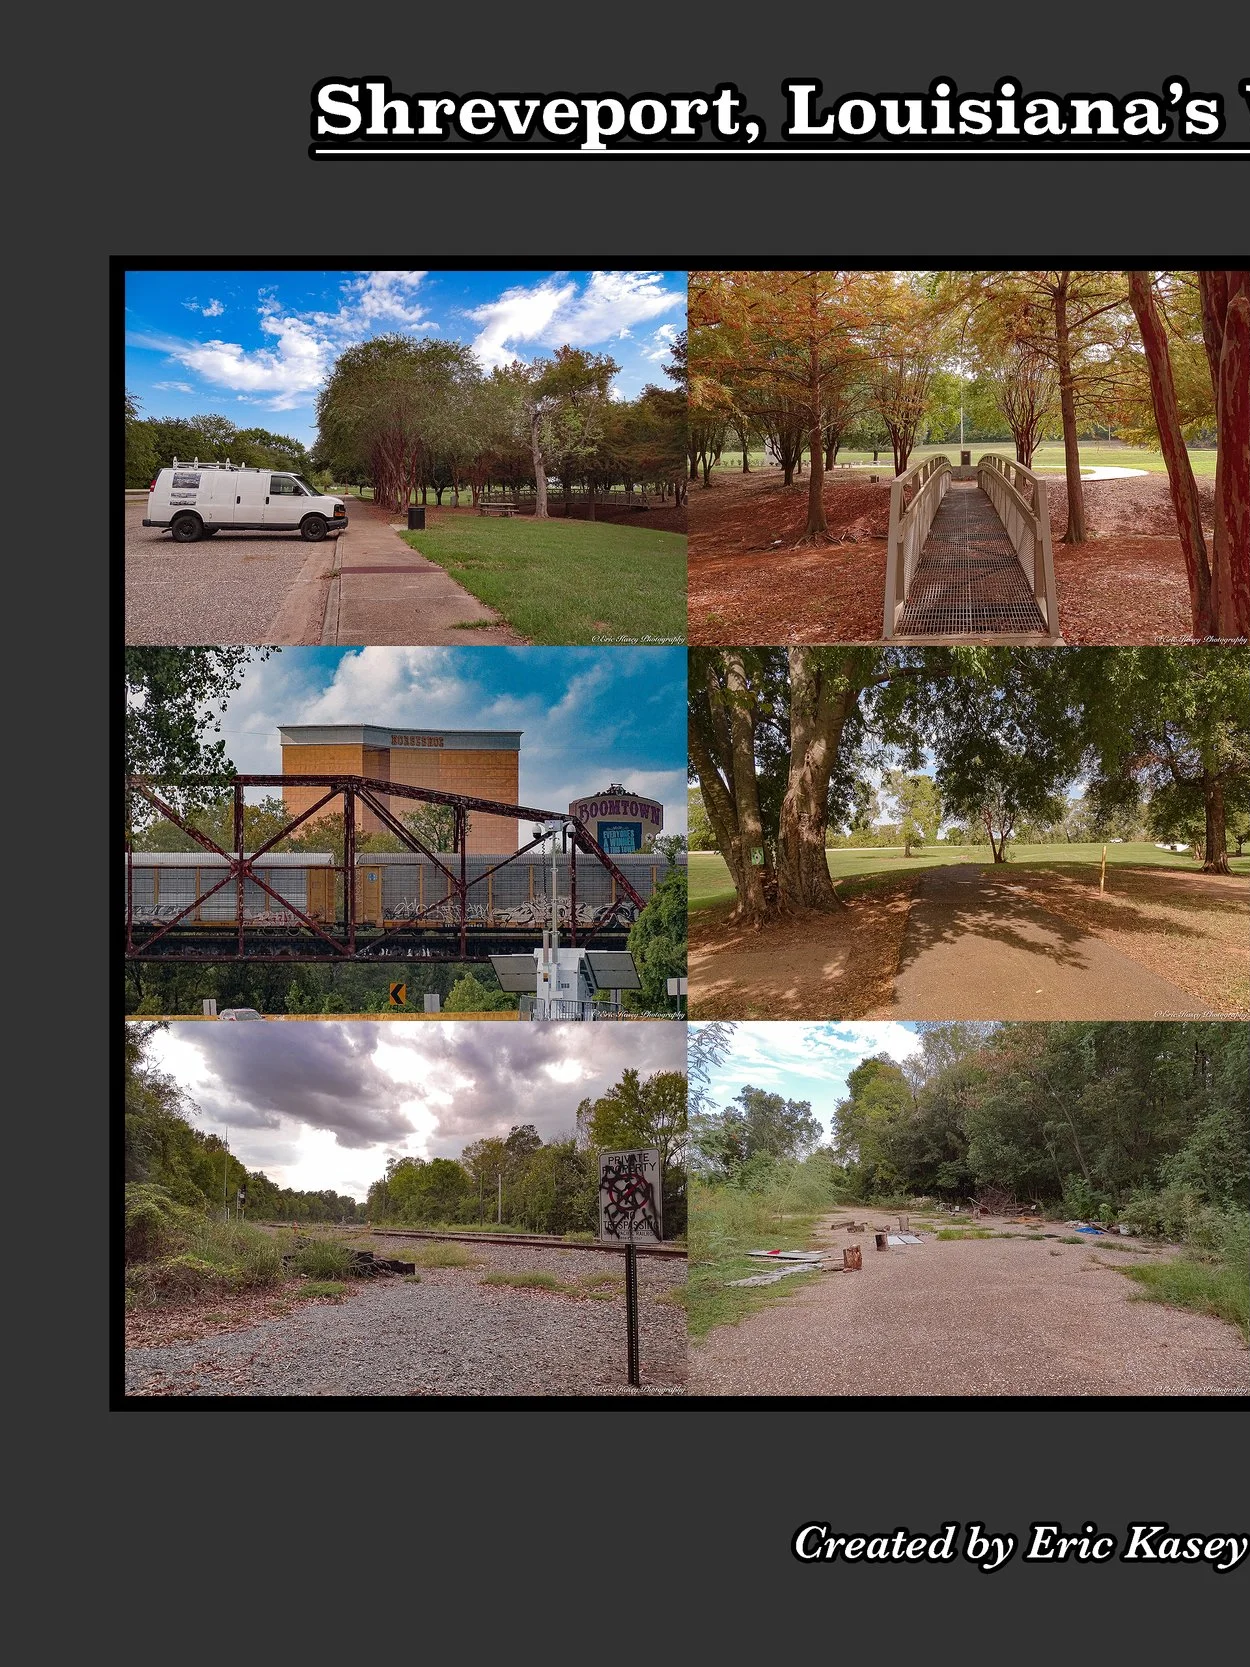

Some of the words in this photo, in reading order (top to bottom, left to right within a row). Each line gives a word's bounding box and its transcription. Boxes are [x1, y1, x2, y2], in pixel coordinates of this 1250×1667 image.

[578, 799, 661, 826] BOOMTOWN
[608, 1153, 650, 1165] PRIVATE
[602, 1162, 657, 1175] PROPERTY
